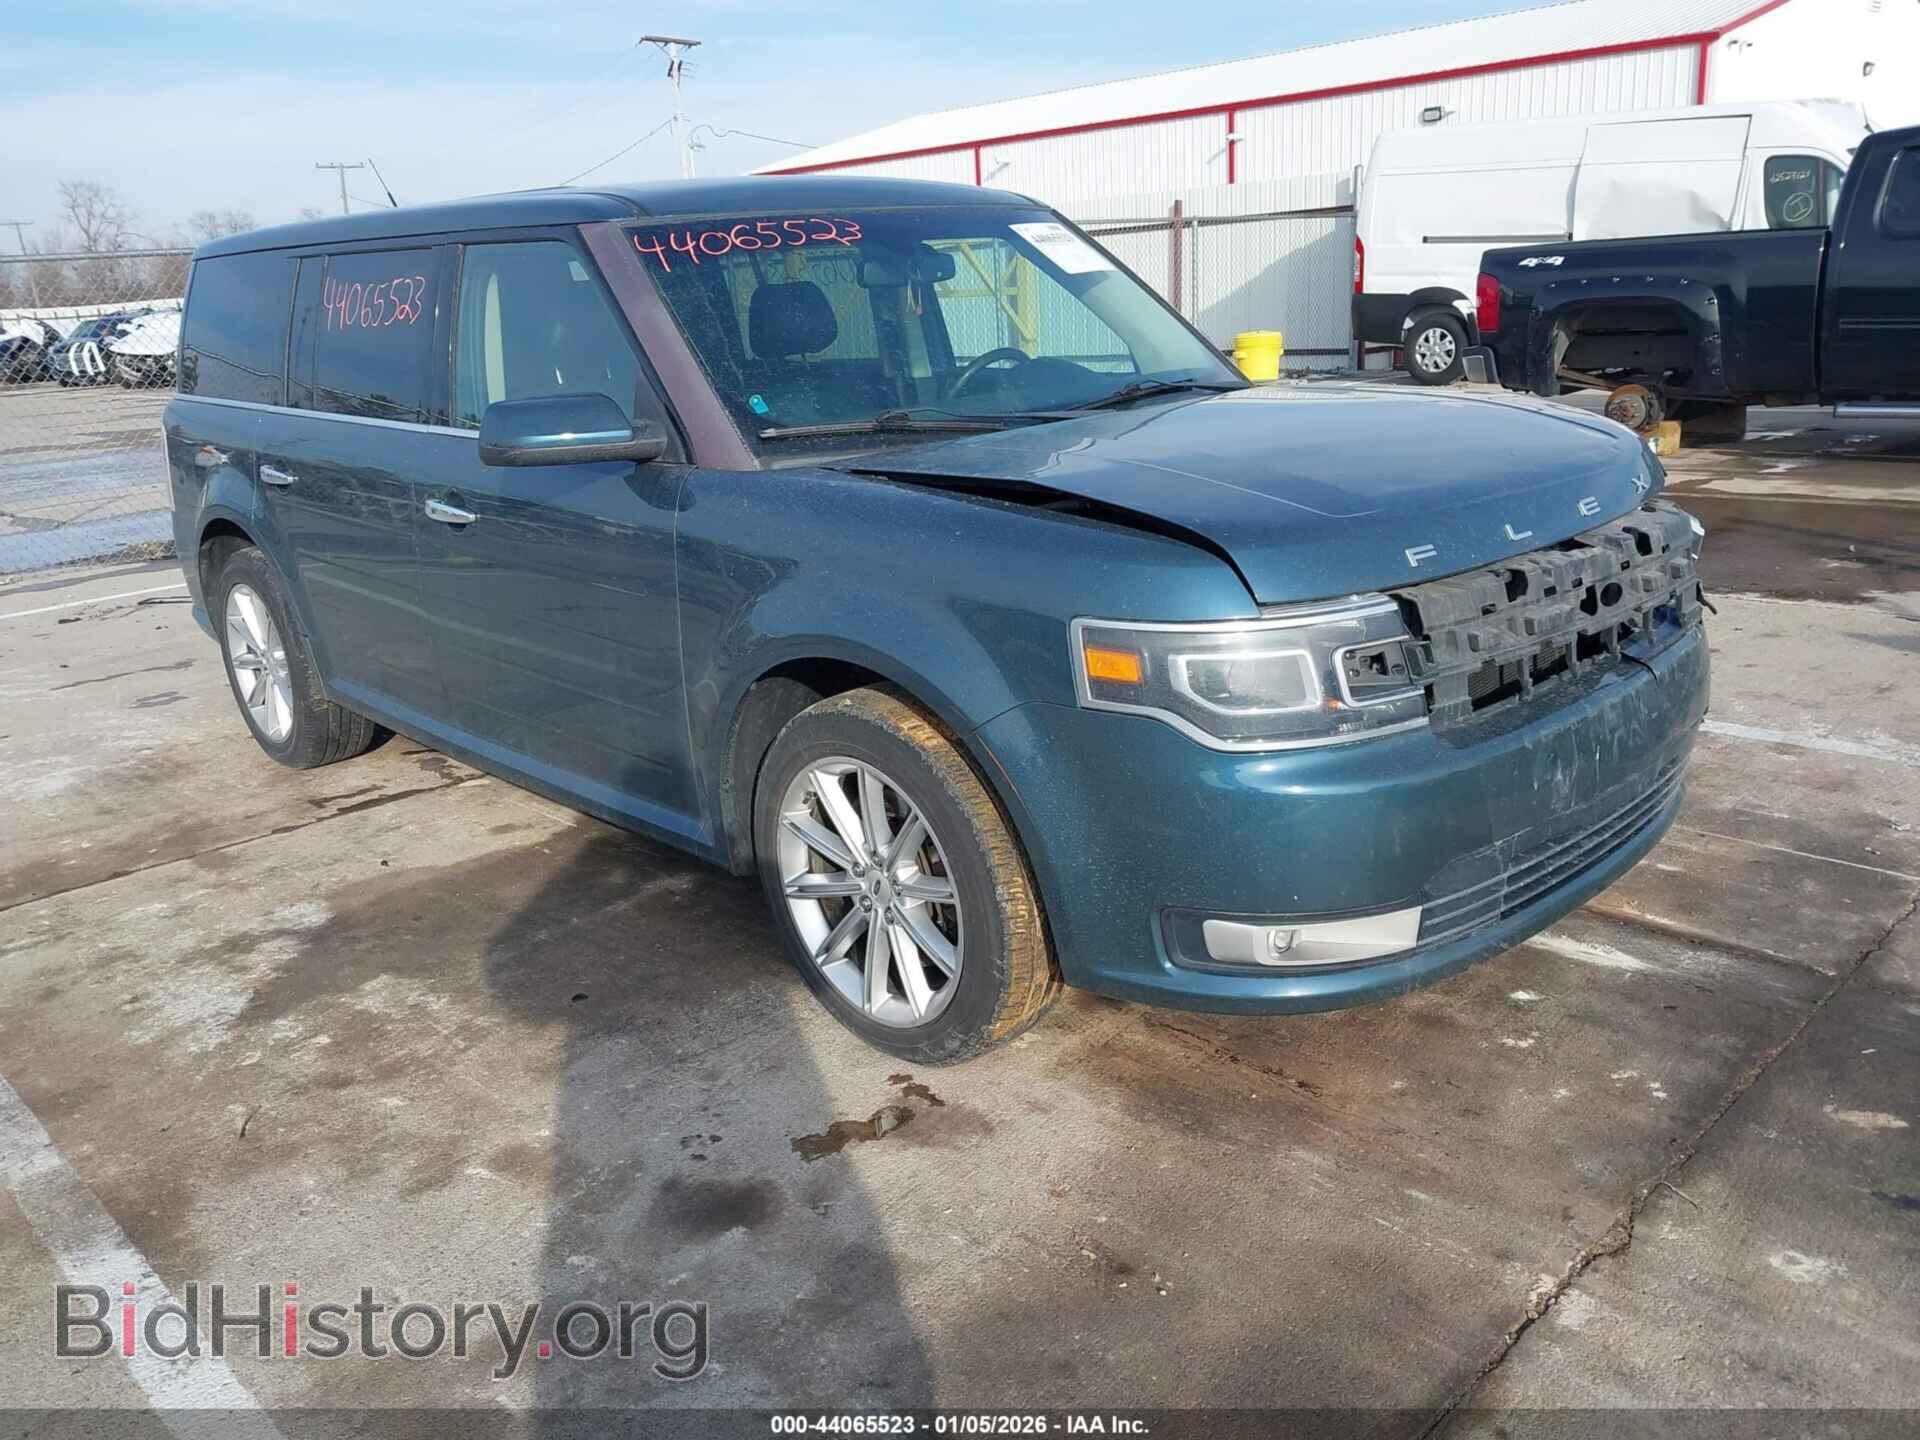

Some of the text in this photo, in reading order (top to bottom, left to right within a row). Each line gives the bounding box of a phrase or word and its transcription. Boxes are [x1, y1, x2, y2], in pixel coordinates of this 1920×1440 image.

[633, 218, 863, 272] 44065523
[323, 276, 426, 332] 44065523
[1404, 473, 1649, 568] FLEX
